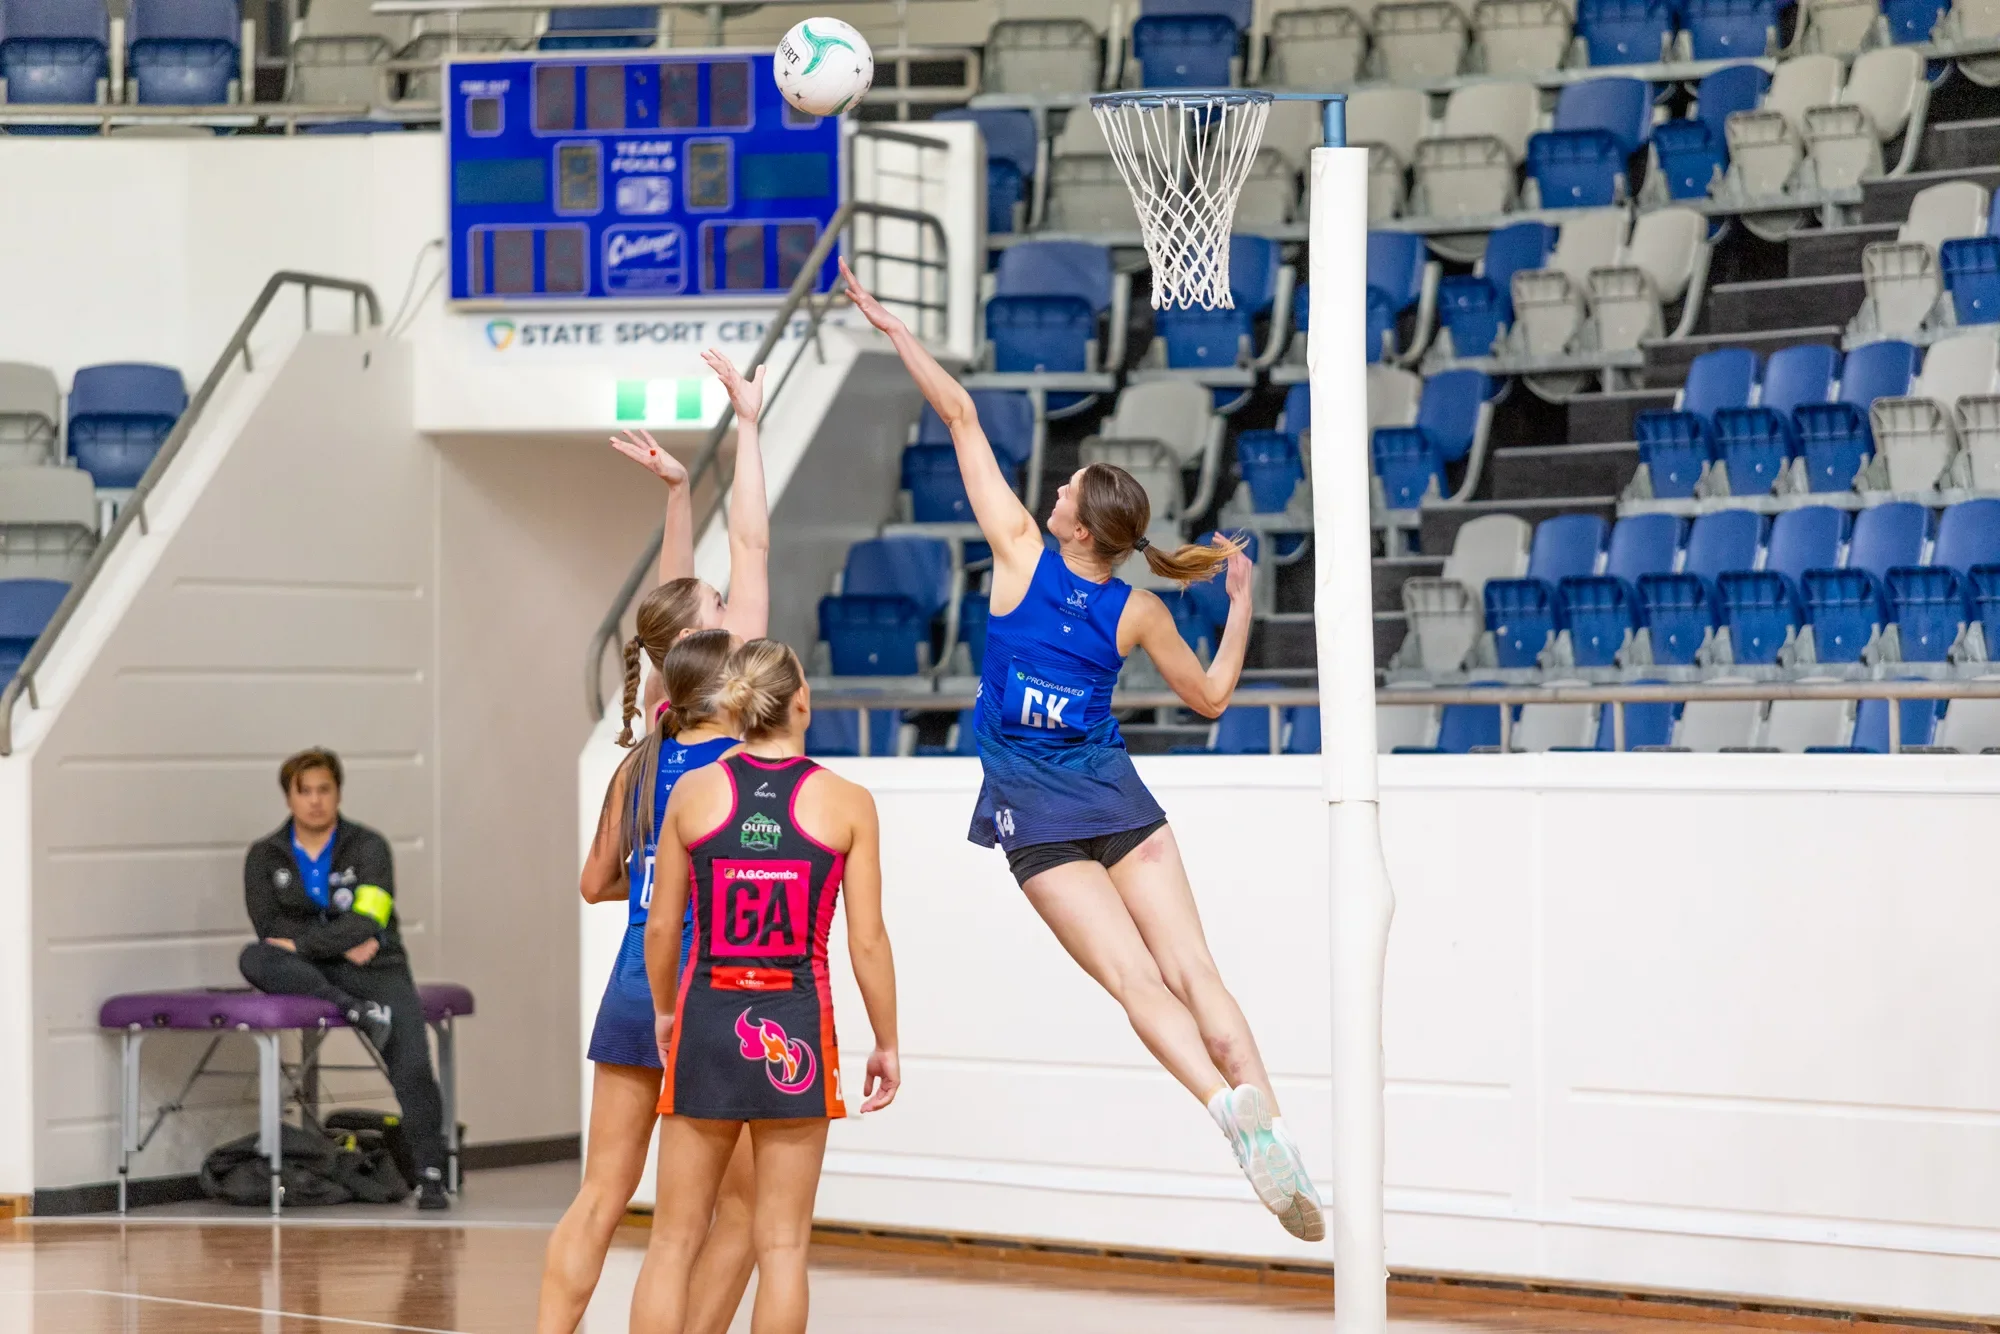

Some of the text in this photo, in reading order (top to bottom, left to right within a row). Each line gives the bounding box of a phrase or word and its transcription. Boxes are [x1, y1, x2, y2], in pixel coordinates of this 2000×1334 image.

[616, 141, 672, 157] TEAM
[521, 322, 603, 346] STATE
[615, 320, 704, 344] SPORT
[1026, 675, 1085, 697] PROGRAMMED
[1020, 686, 1069, 729] GK
[741, 822, 782, 833] OUTER
[740, 830, 782, 848] EAST
[736, 870, 798, 880] A.G.Coombs
[724, 881, 795, 946] GA
